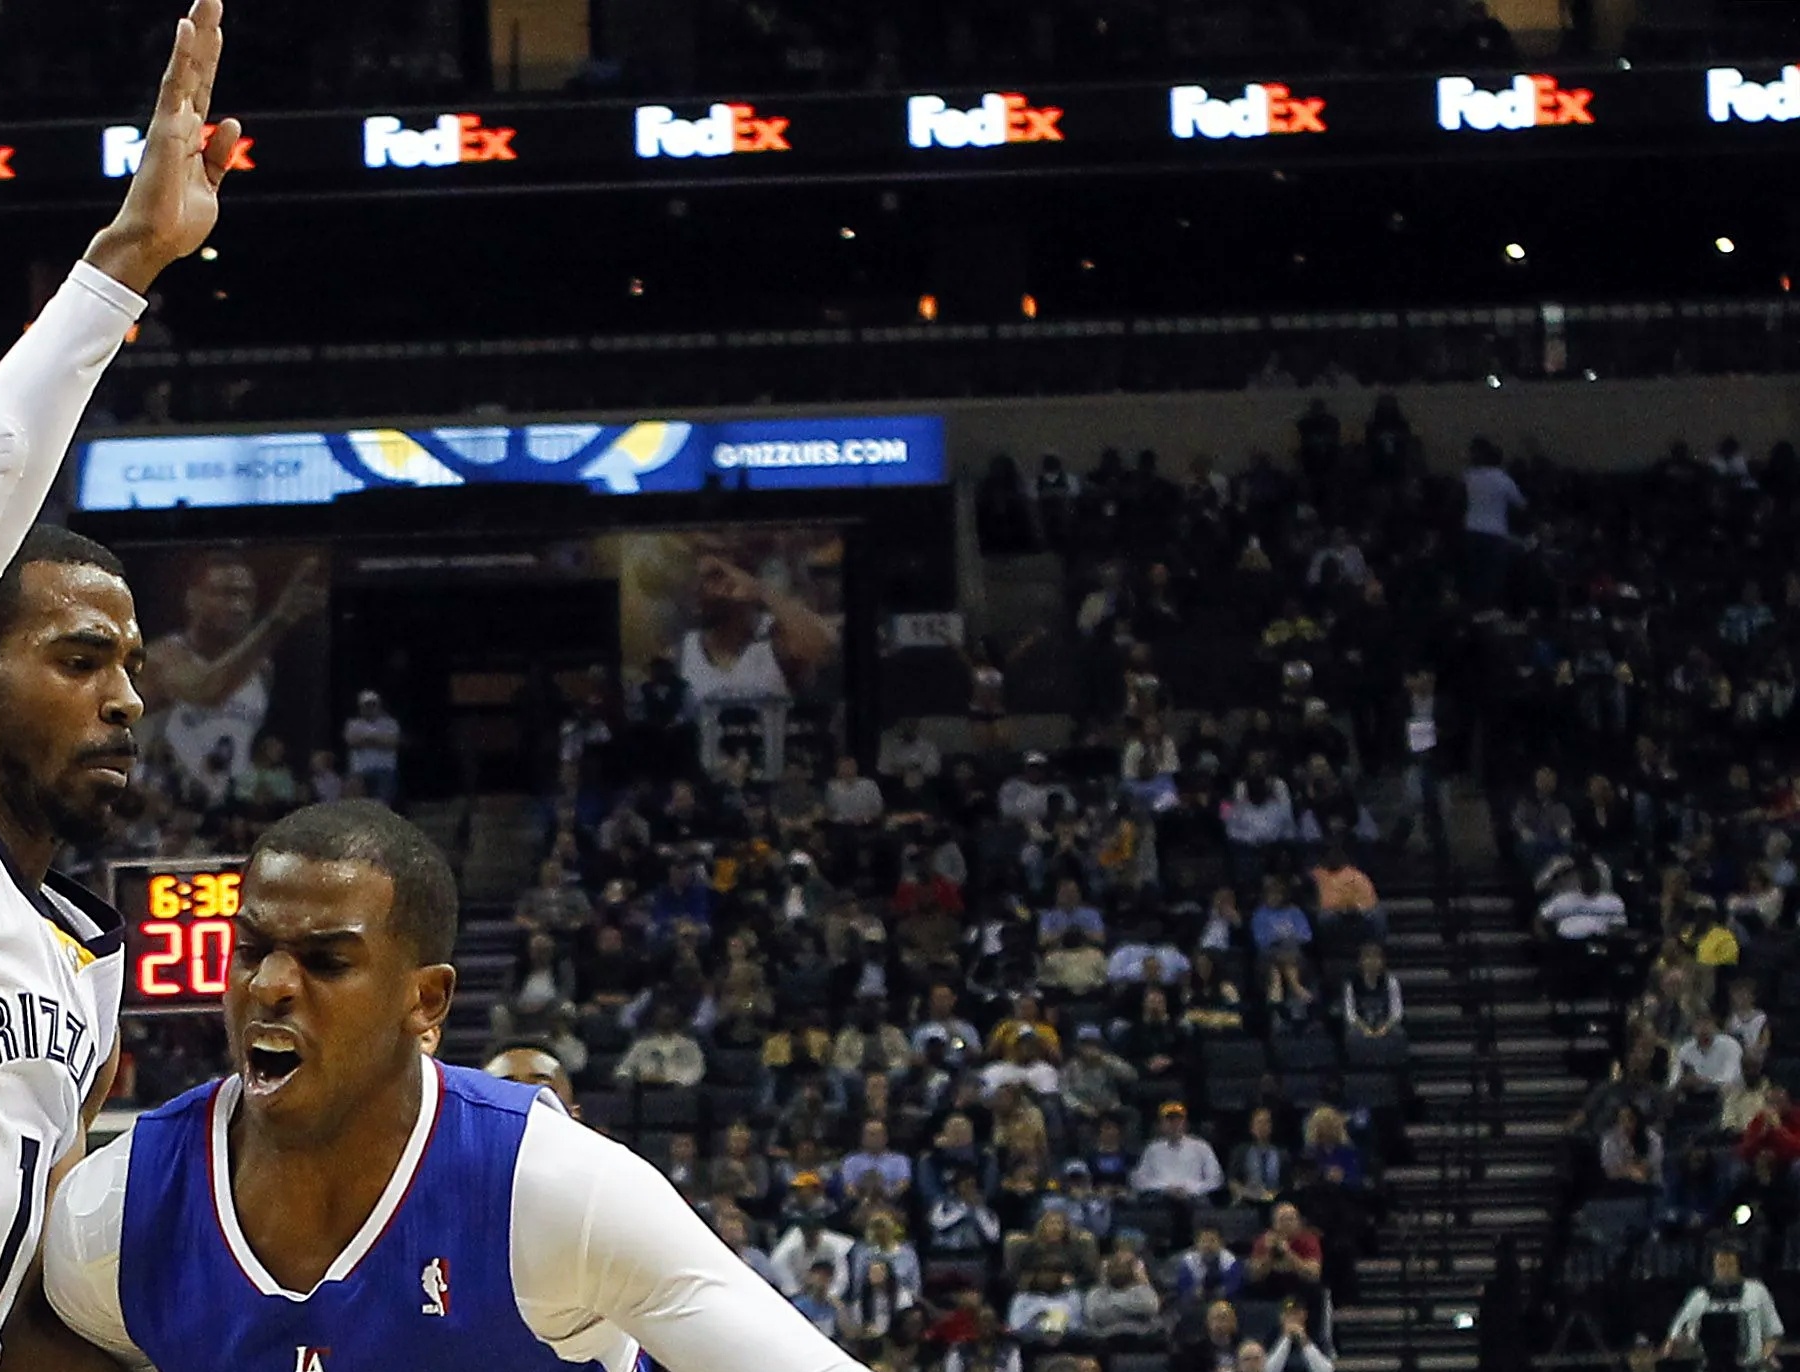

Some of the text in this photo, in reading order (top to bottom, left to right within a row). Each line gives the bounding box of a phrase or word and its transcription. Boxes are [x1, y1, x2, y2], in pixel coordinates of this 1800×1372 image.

[908, 93, 1063, 148] FedEx
[1170, 83, 1326, 139] FedEx
[1437, 75, 1594, 130] FedEx
[1707, 65, 1800, 122] Fed
[364, 114, 516, 168] FedEx
[635, 103, 790, 158] FedEx
[712, 438, 908, 468] GRIZZLIES.COM
[149, 873, 242, 919] 6:36
[137, 920, 235, 996] 20
